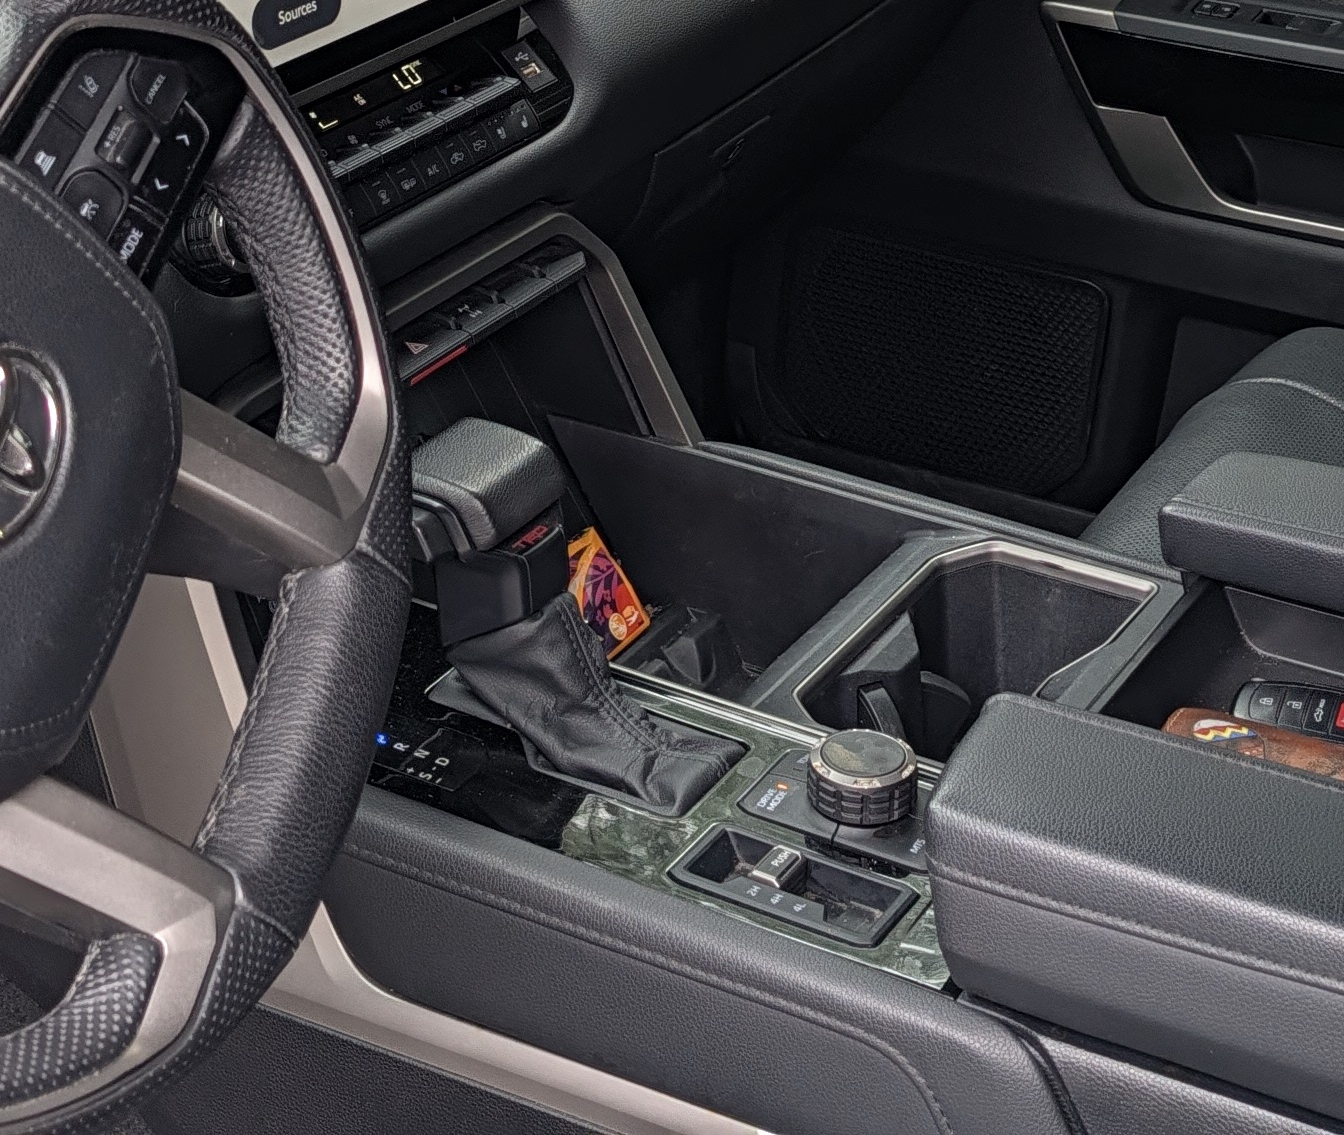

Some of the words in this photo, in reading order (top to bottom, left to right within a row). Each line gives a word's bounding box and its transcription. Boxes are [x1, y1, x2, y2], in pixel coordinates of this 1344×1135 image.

[278, 0, 318, 25] Sources
[145, 73, 167, 105] CANCEL
[120, 226, 144, 261] MODE
[393, 742, 410, 752] R
[413, 748, 431, 760] N
[434, 757, 451, 767] D
[418, 771, 433, 781] S
[756, 787, 777, 808] DRIVE
[766, 789, 788, 812] MODE
[770, 849, 792, 867] PUSH
[745, 884, 762, 897] 2H
[770, 893, 784, 905] 4H
[792, 903, 807, 913] 4L
